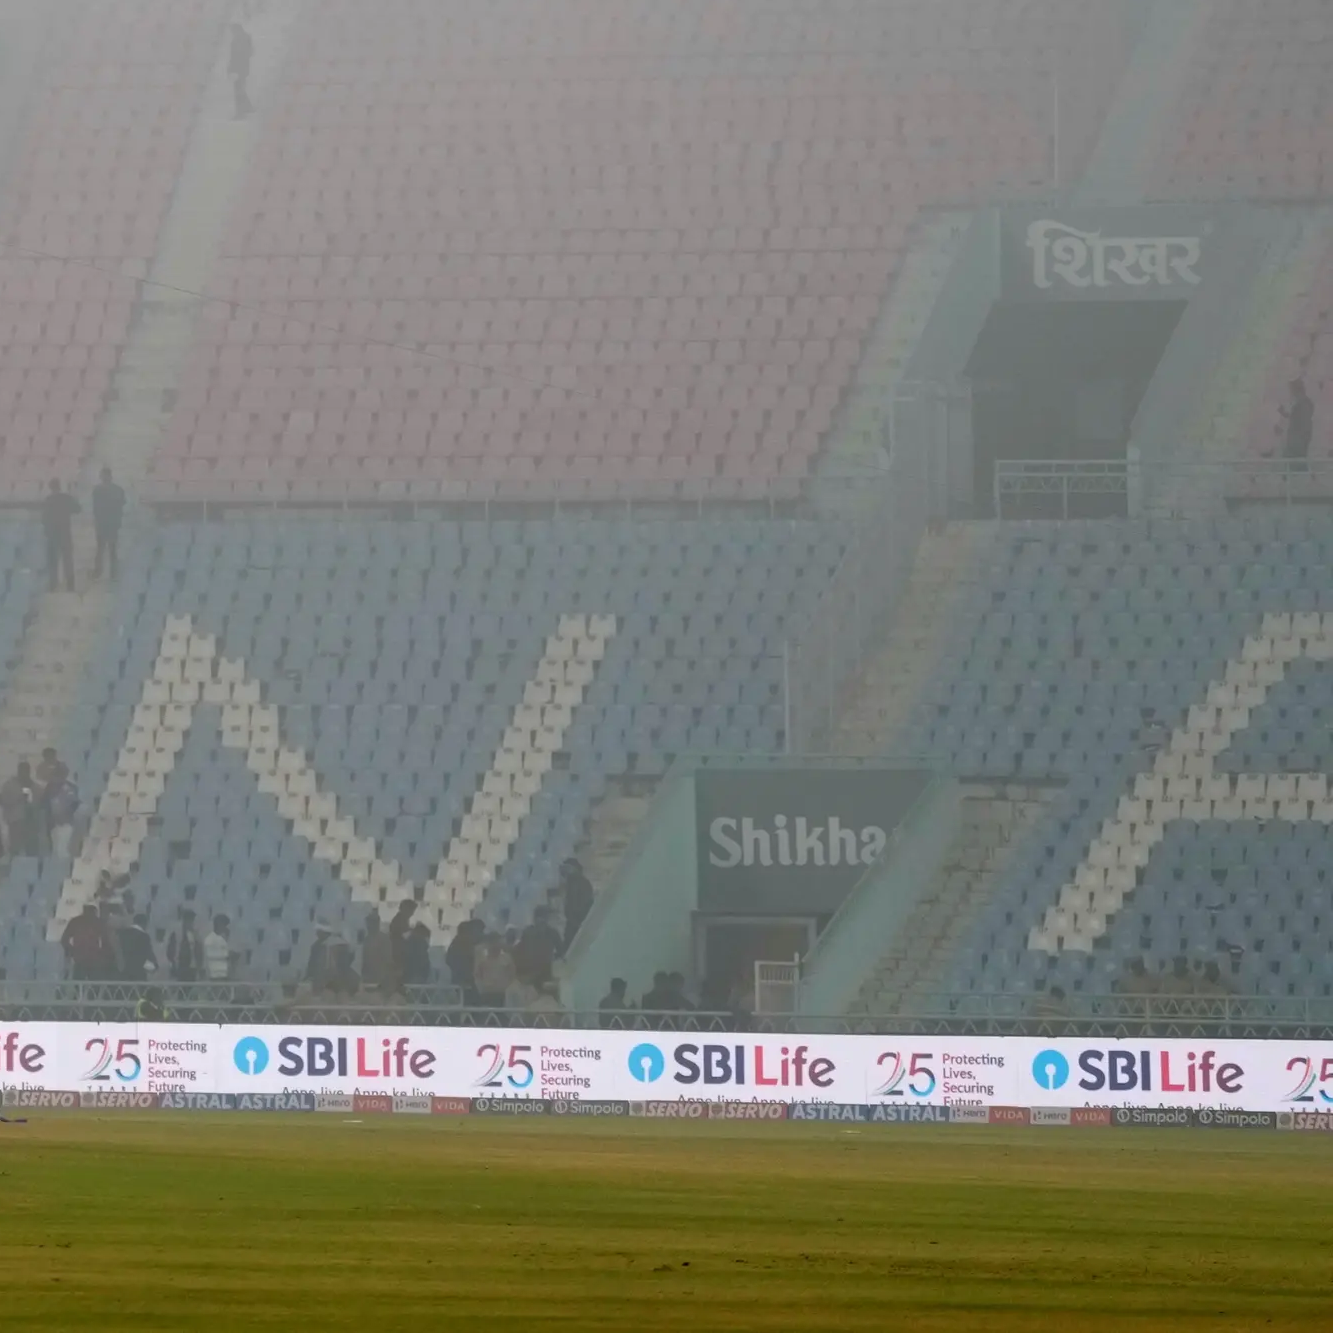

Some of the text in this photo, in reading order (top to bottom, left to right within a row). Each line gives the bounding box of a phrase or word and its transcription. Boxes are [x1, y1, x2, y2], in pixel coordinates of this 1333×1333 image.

[1025, 219, 1202, 288] शिखर
[148, 1039, 207, 1054] Protecting
[540, 1045, 601, 1062] Protecting
[84, 1037, 142, 1082] 25
[277, 1036, 437, 1079] SBI Life
[476, 1043, 534, 1089] 25
[673, 1043, 836, 1088] SBI Life
[942, 1052, 1005, 1070] Protecting
[148, 1066, 197, 1081] Securing
[876, 1051, 937, 1098] 25
[1078, 1049, 1245, 1094] SBI Life
[540, 1073, 591, 1090] Securing
[942, 1081, 994, 1098] Securing
[238, 1094, 313, 1110] ASTRAL
[873, 1106, 947, 1123] ASTRAL
[994, 1110, 1024, 1122] VIDA
[1132, 1109, 1188, 1125] Simpolo
